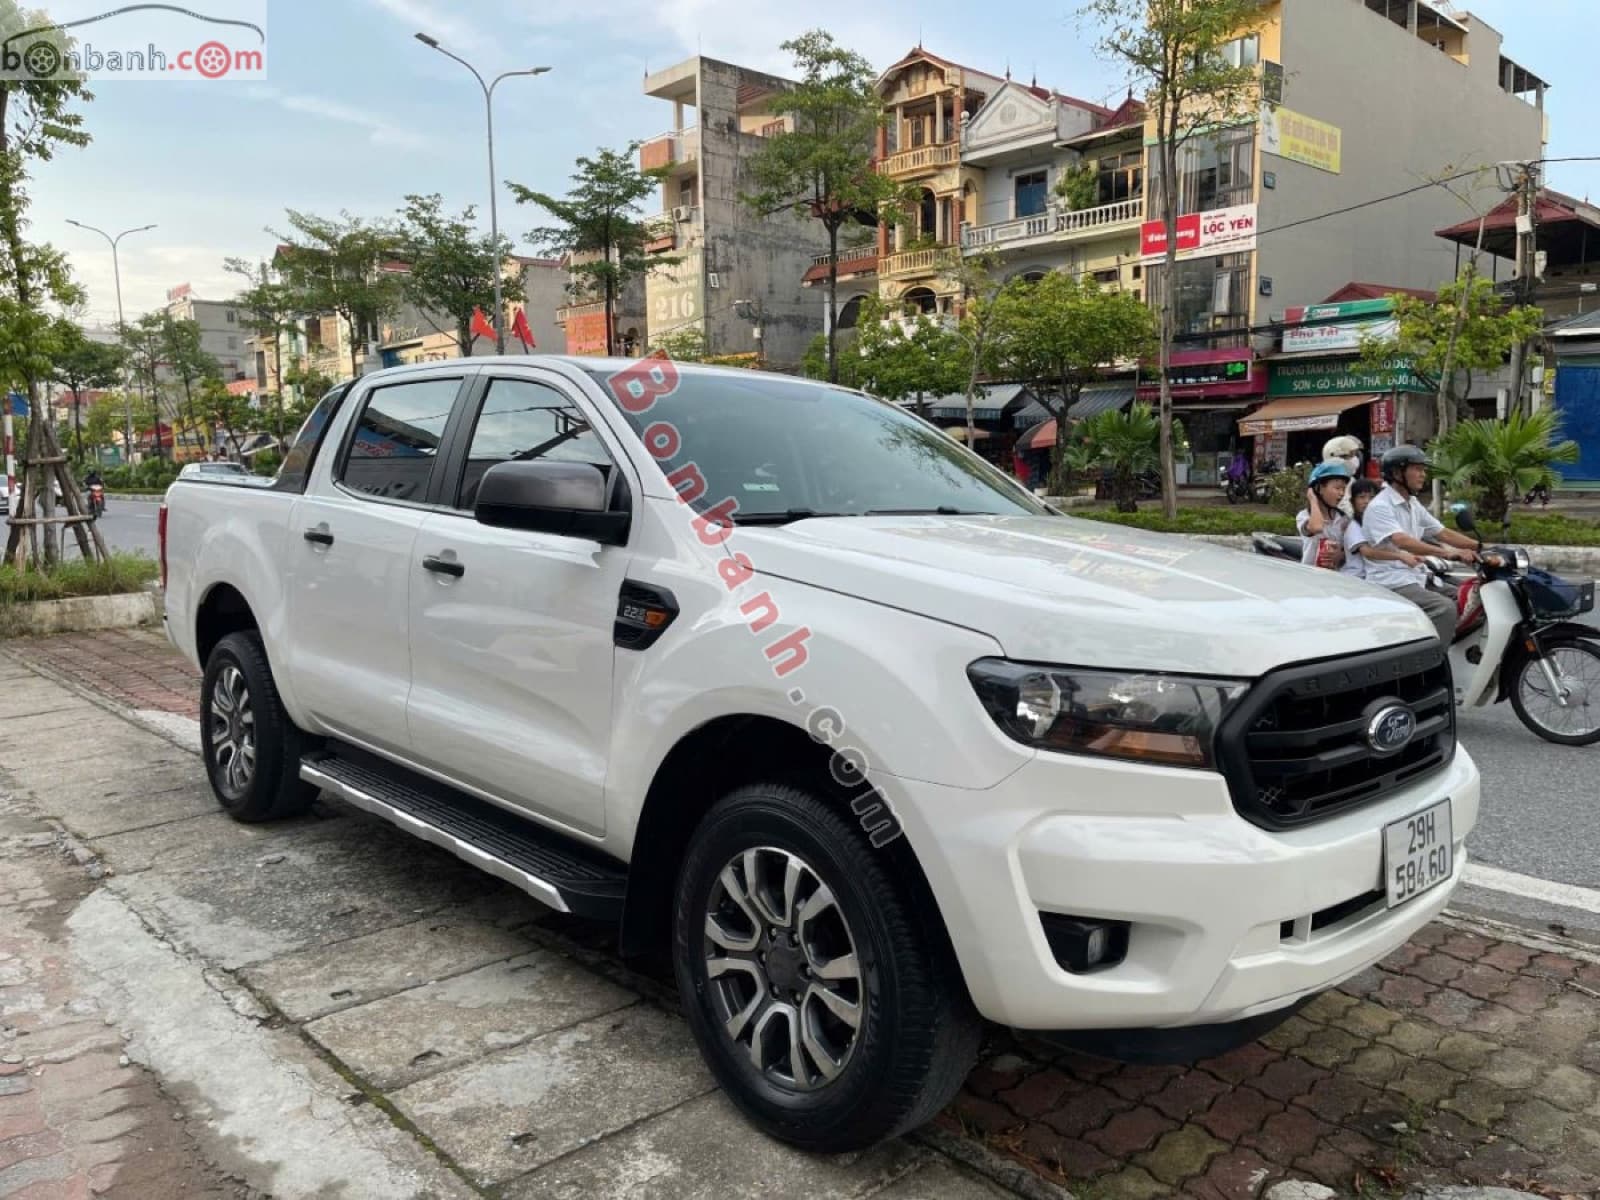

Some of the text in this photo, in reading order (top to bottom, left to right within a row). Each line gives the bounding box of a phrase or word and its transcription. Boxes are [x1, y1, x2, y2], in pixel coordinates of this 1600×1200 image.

[655, 291, 695, 320] 216
[1386, 713, 1409, 743] Ford
[1407, 811, 1435, 855] 29H
[1395, 845, 1446, 900] 584.60
